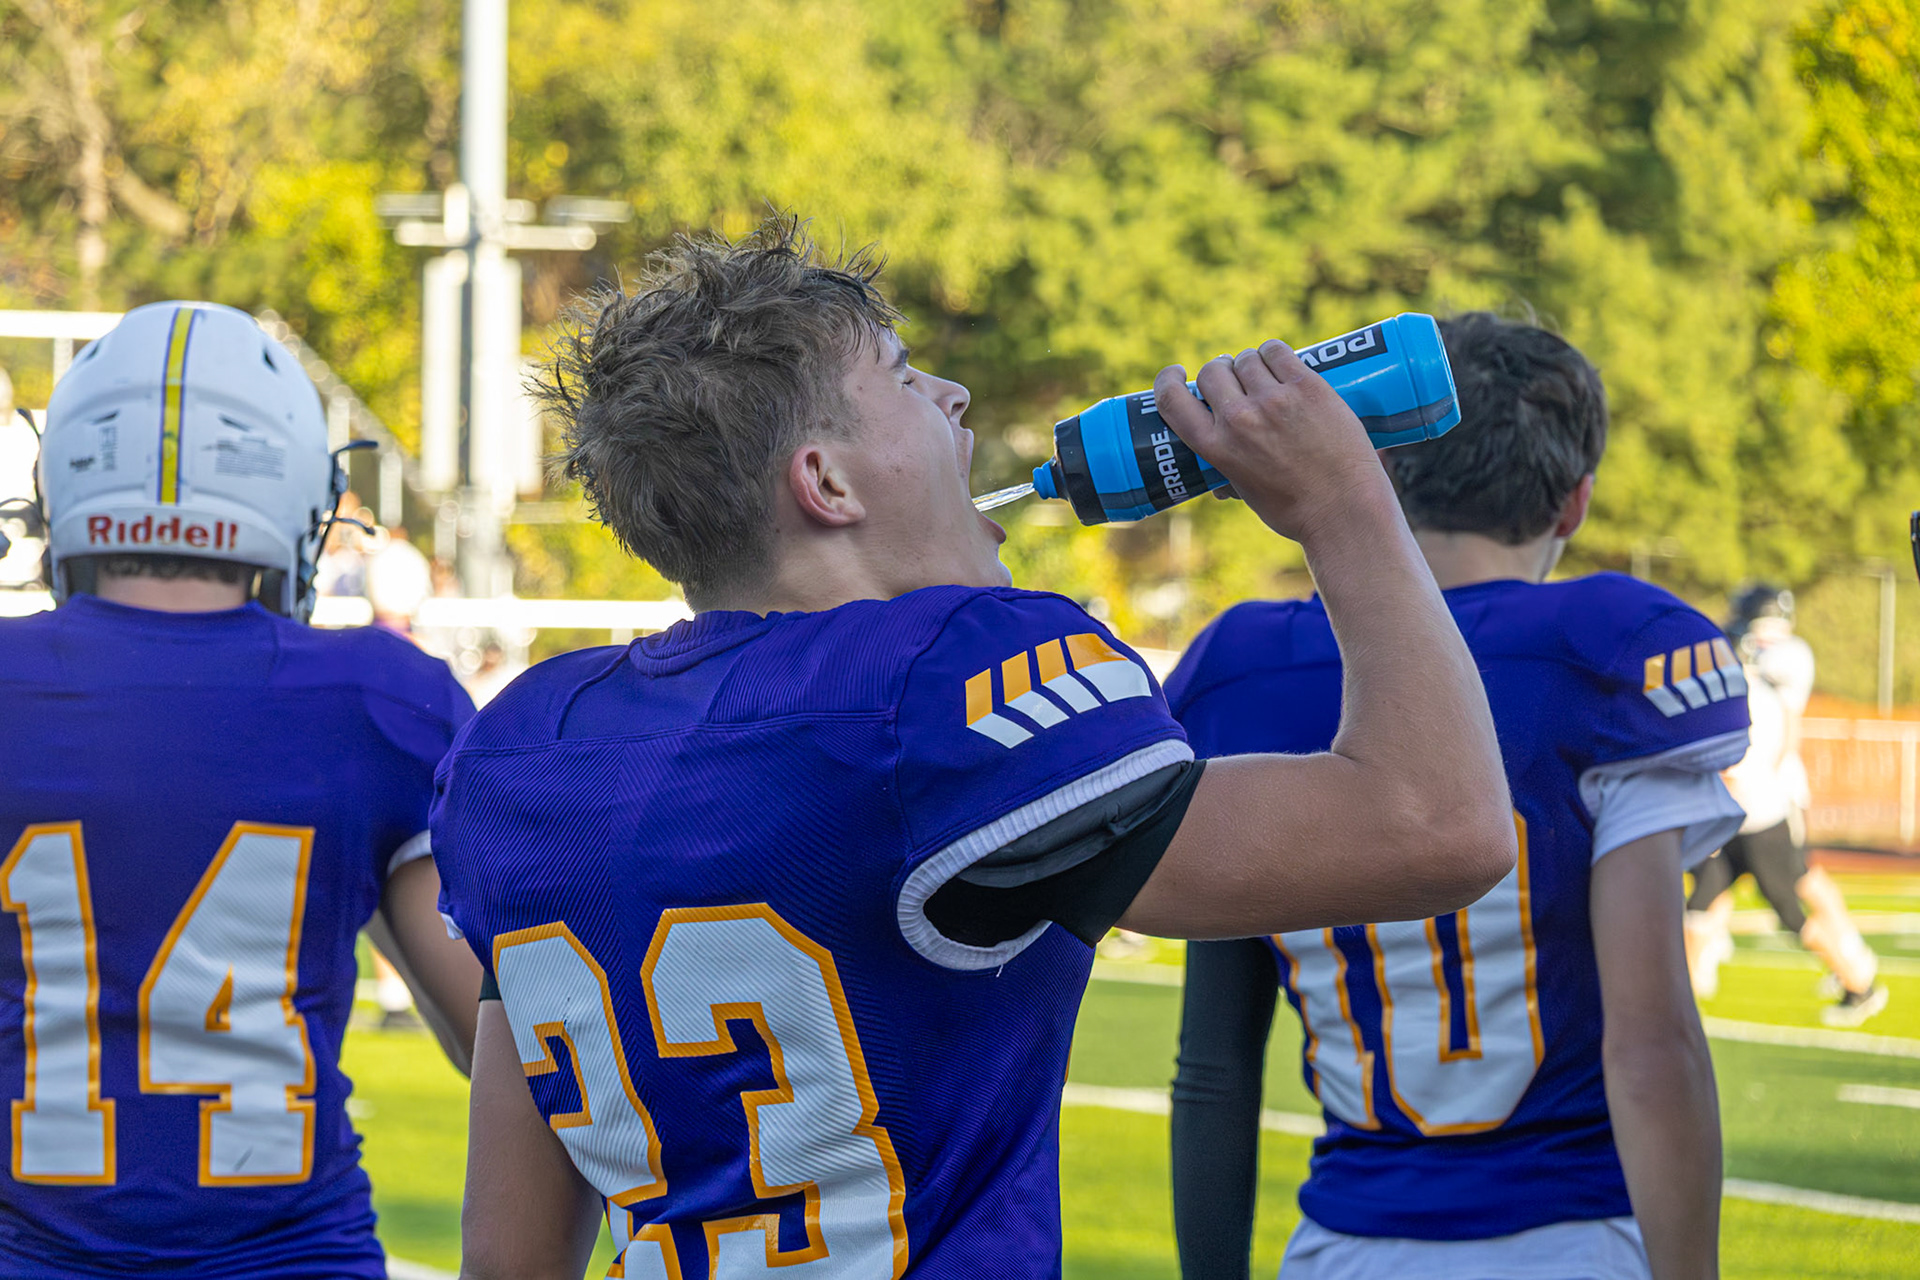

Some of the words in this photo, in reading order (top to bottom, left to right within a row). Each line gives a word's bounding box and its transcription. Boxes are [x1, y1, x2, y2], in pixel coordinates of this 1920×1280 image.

[1150, 430, 1189, 502] ERADE
[87, 514, 239, 551] Riddell
[0, 820, 316, 1187] 14
